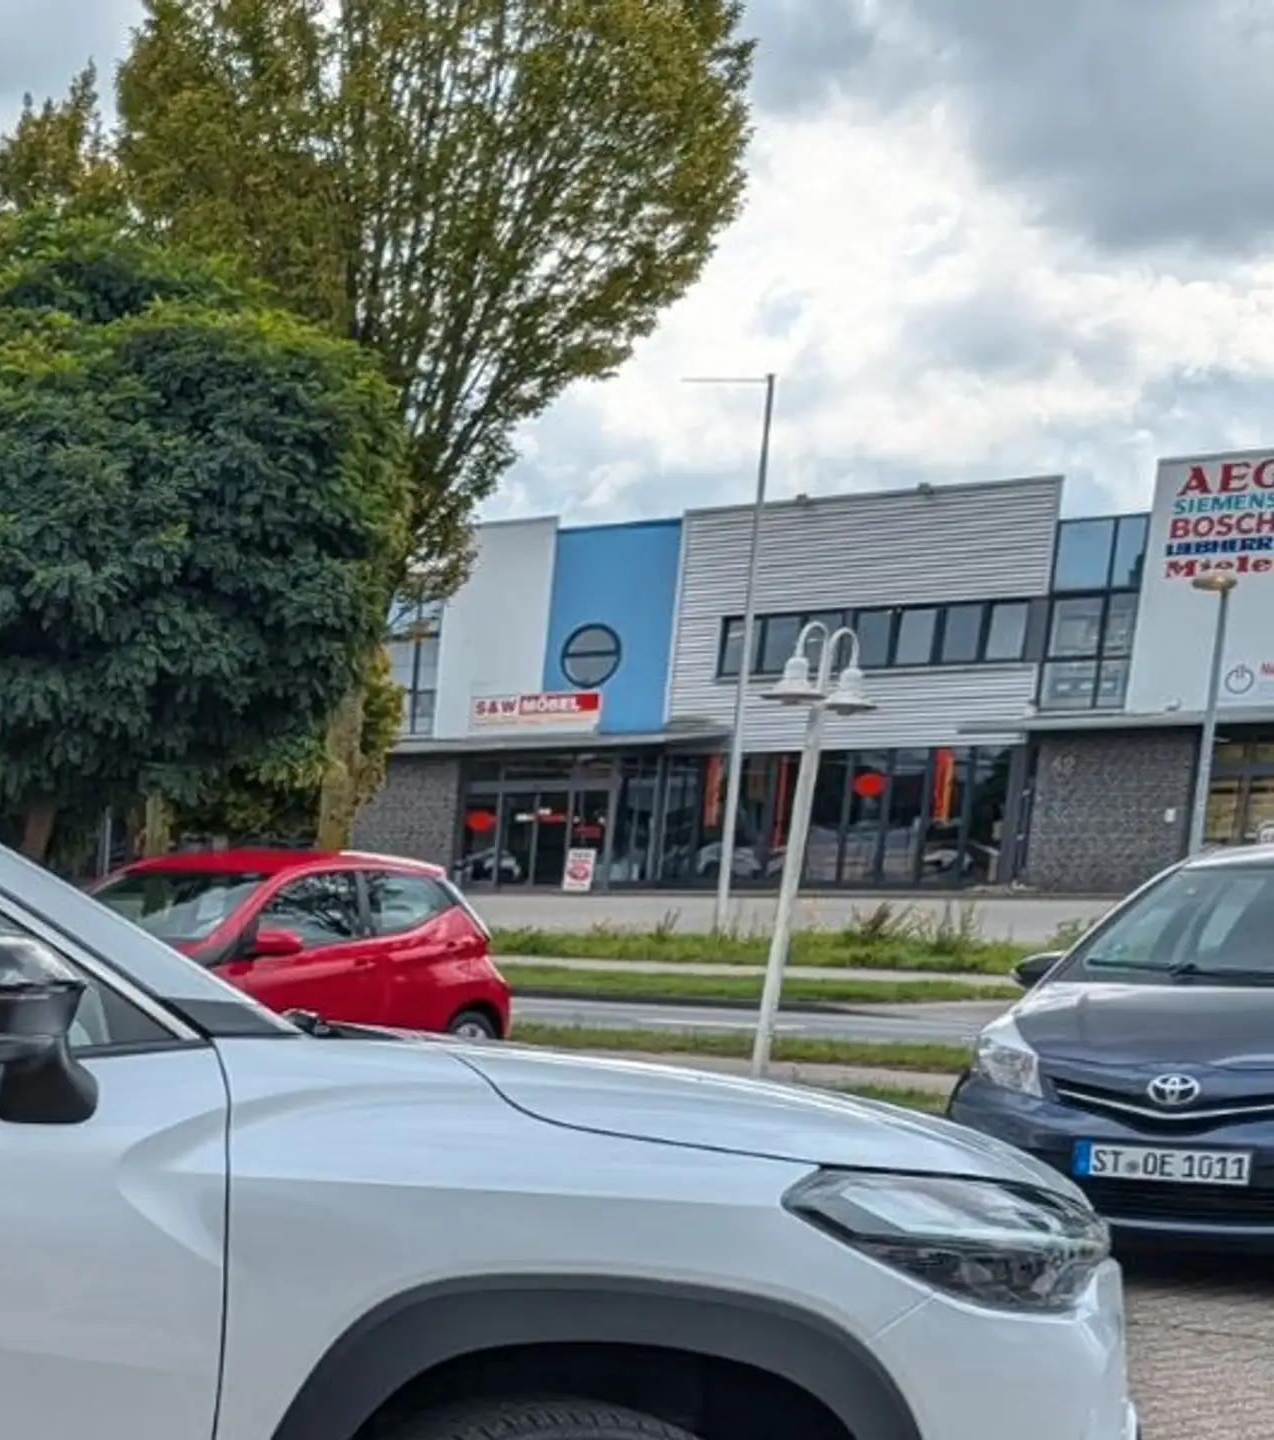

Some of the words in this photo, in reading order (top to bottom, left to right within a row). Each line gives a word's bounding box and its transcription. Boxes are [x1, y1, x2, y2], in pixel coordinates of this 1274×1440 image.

[1174, 491, 1274, 515] SIEMENS
[1170, 511, 1274, 539] BOSCH
[1165, 555, 1273, 578] Miele
[1093, 1150, 1123, 1173] ST
[1182, 1154, 1245, 1180] 1011
